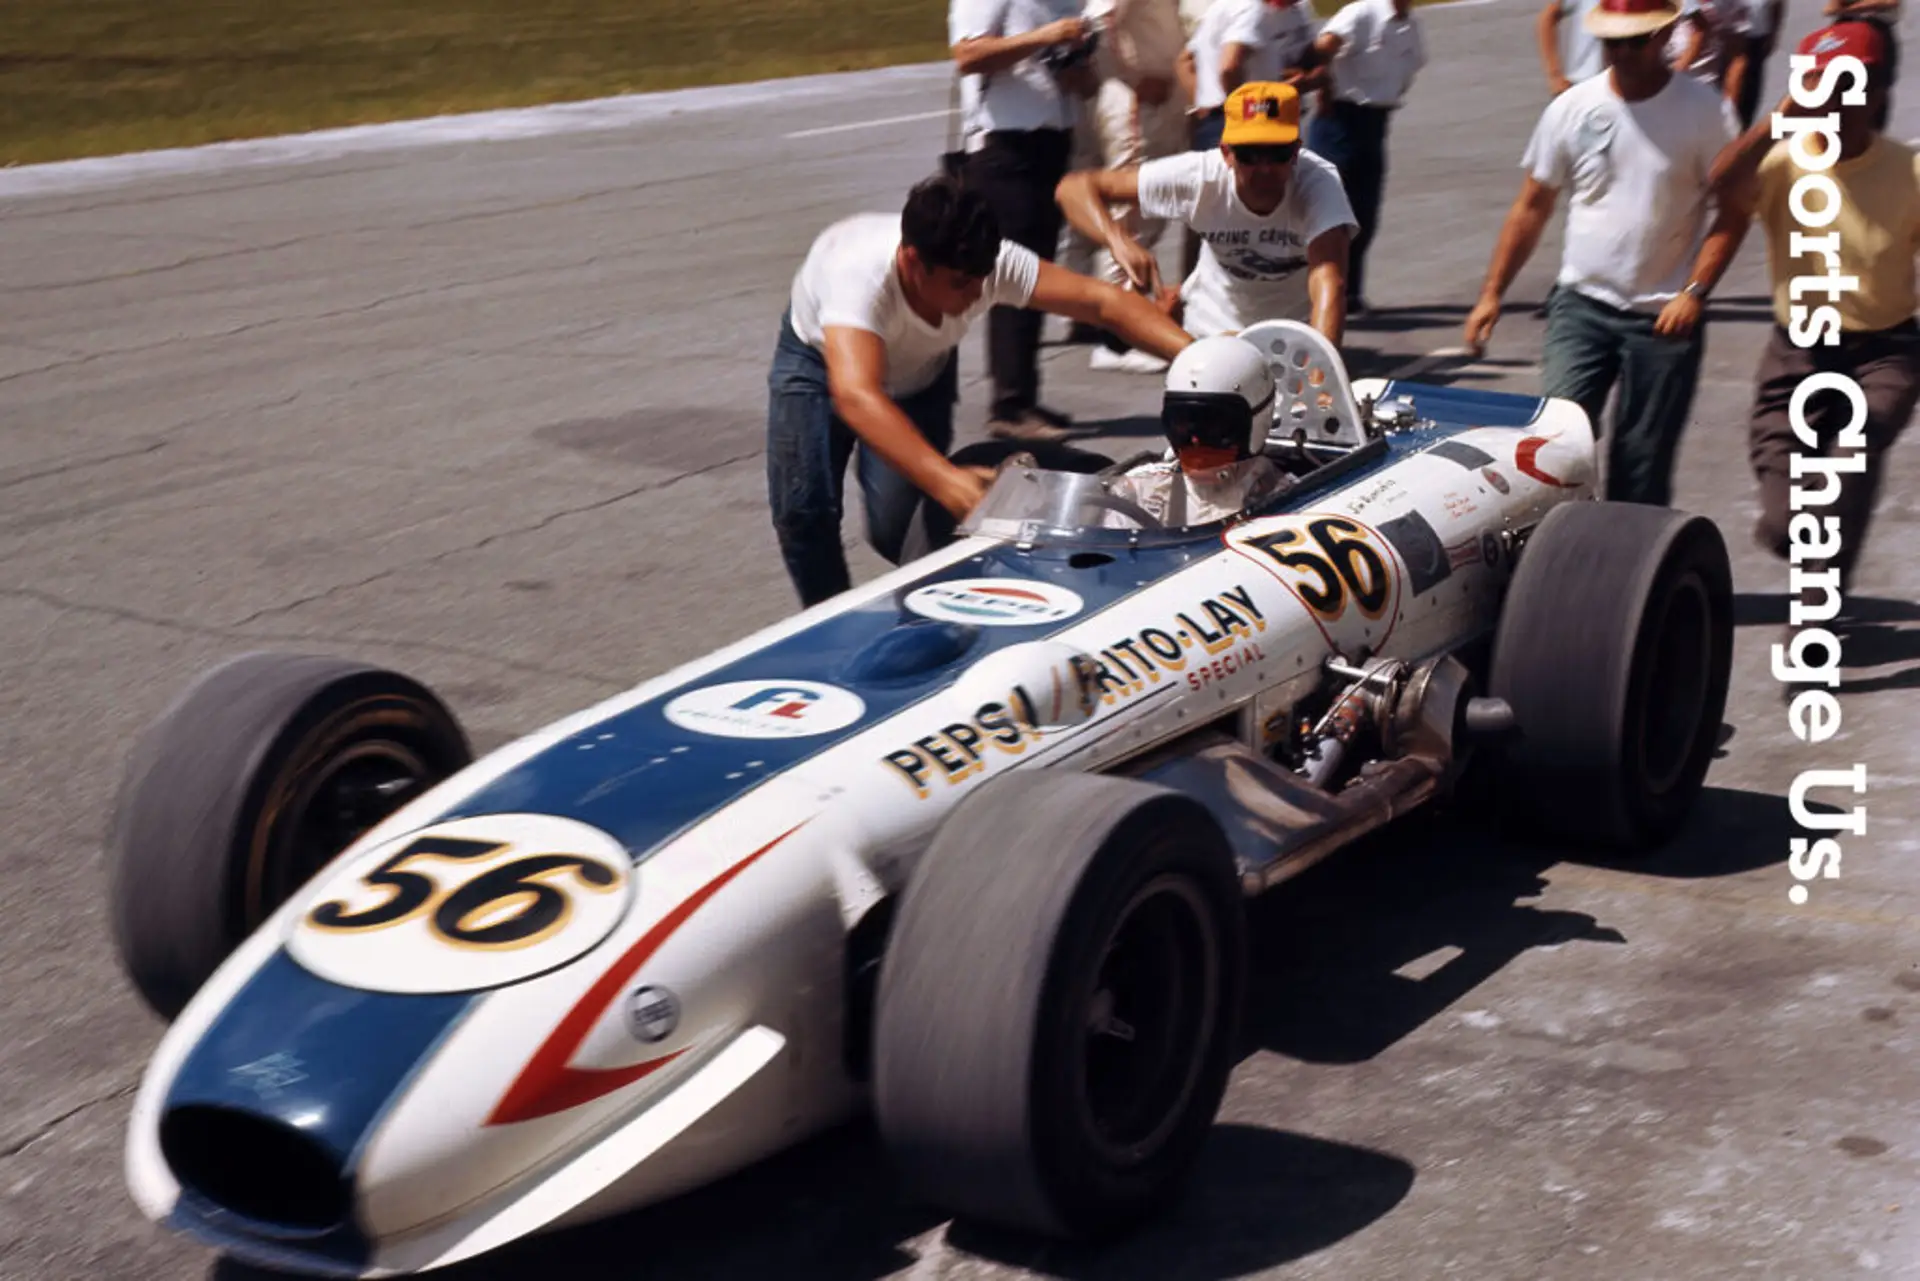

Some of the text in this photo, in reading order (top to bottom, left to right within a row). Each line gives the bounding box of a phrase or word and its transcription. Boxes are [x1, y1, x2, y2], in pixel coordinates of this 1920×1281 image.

[921, 588, 1067, 617] PEPSI
[1237, 518, 1391, 621] 56
[1186, 643, 1266, 691] SPECIAL
[881, 685, 1044, 799] PEPSI
[305, 836, 619, 952] 56
